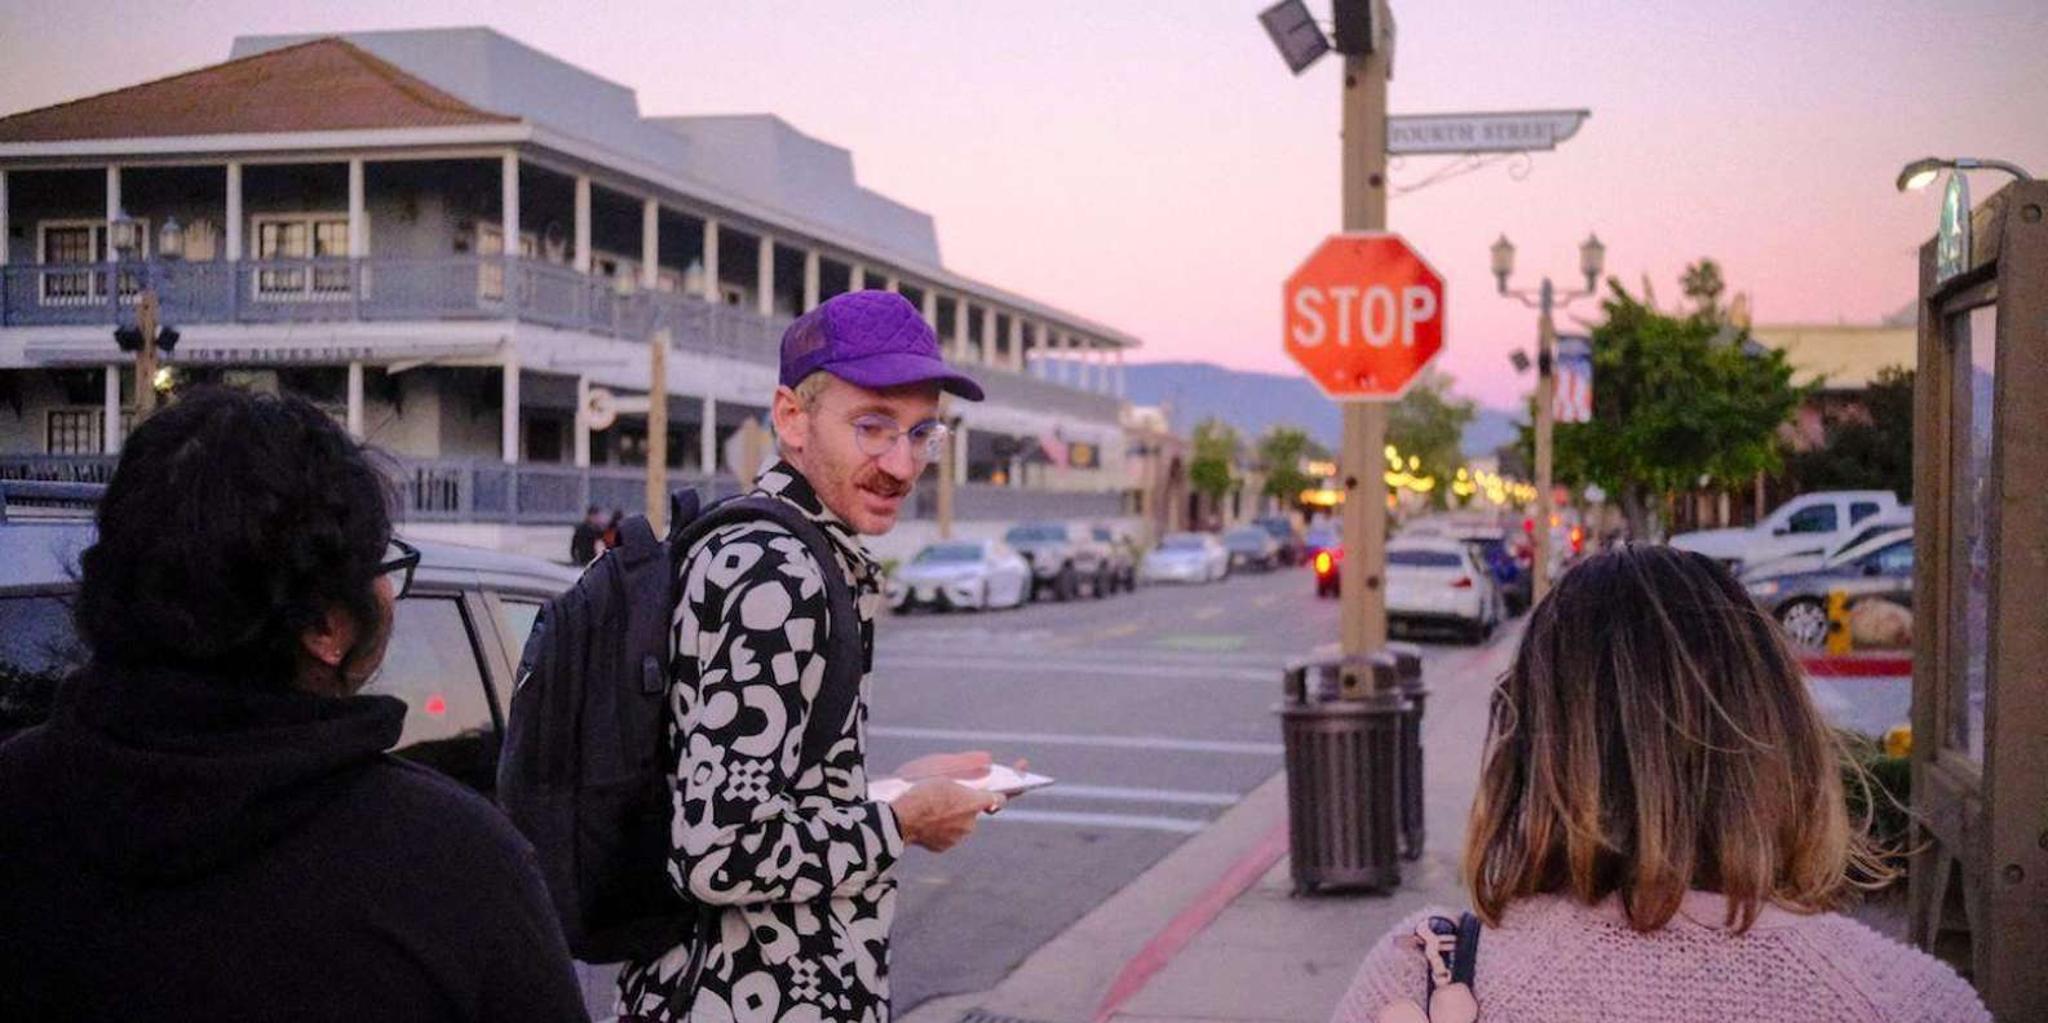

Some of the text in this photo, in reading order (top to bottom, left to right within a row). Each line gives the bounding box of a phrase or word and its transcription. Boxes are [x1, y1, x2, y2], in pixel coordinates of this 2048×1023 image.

[1391, 121, 1560, 143] FOURTH STREET
[1292, 284, 1437, 348] STOP
[188, 348, 240, 362] TOWN
